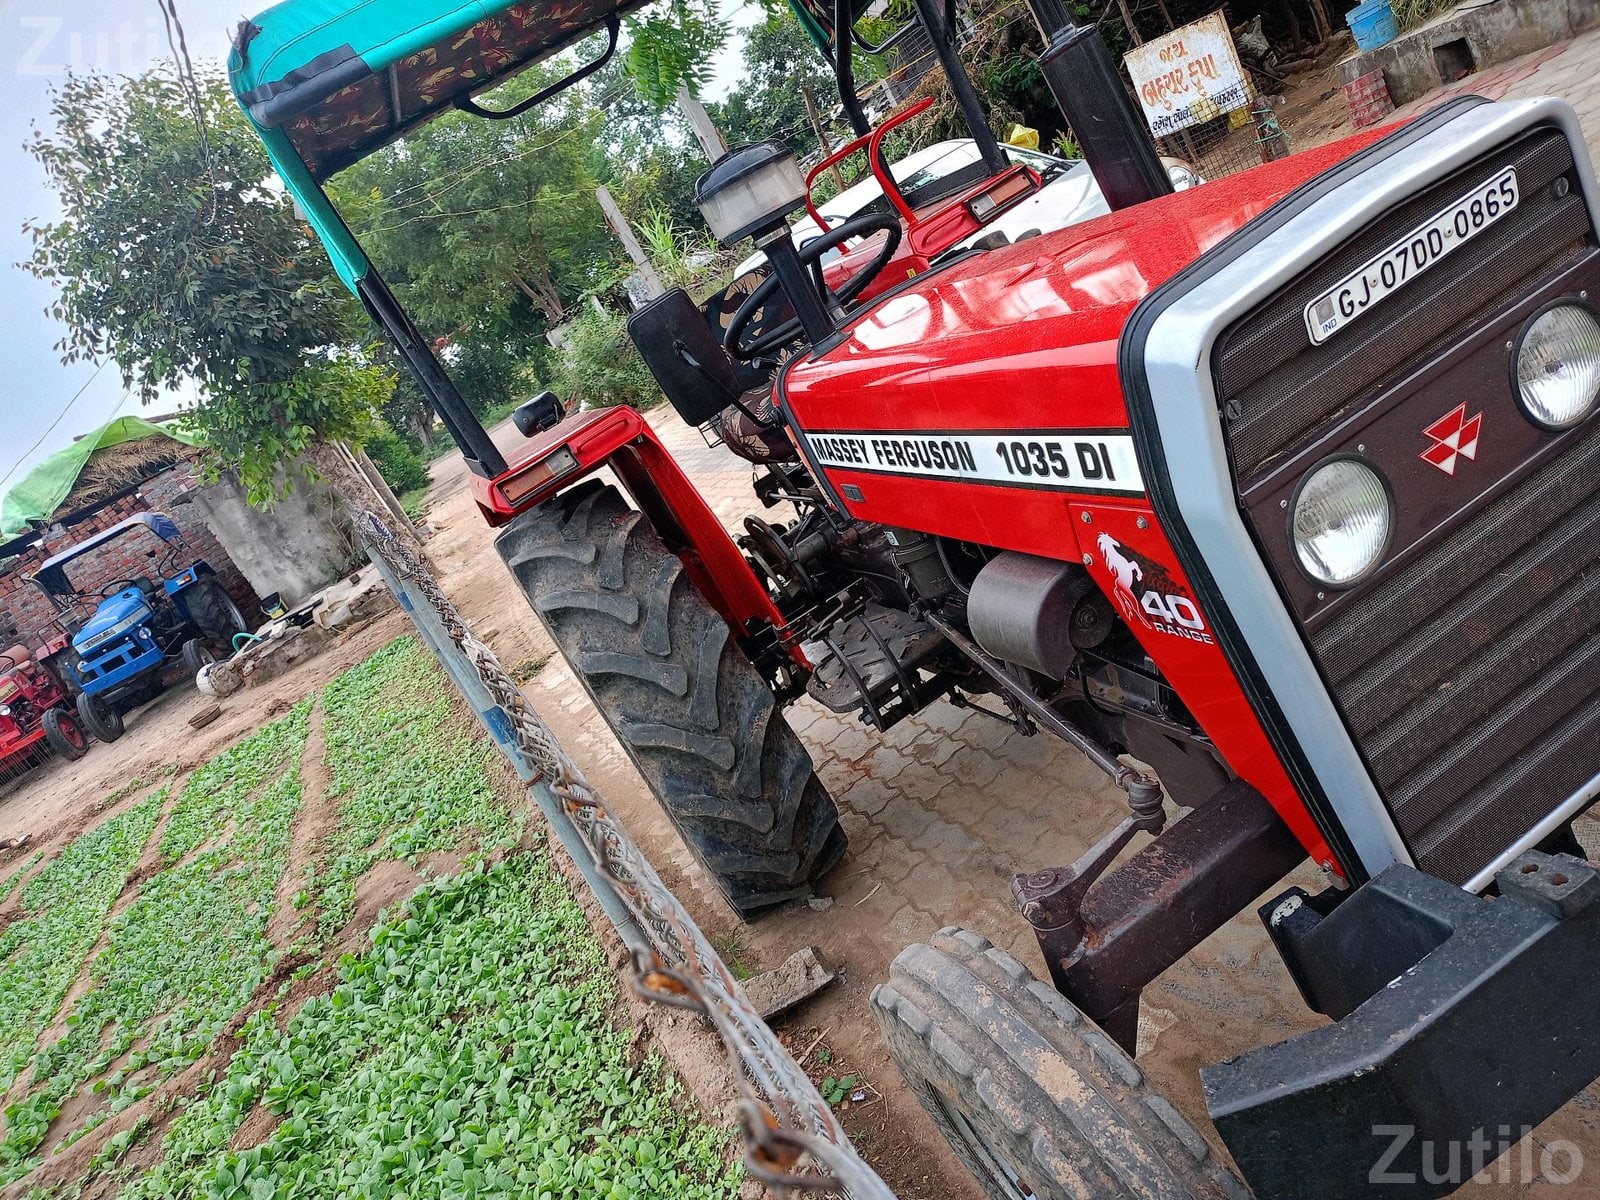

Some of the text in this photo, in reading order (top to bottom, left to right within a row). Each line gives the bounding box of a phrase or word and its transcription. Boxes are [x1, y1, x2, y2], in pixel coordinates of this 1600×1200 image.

[1338, 175, 1515, 317] GJ 07DD 0865
[1322, 318, 1337, 334] IND
[811, 438, 1117, 482] MASSEY FERGUSON 1035 DI
[1140, 590, 1205, 630] 40
[1153, 621, 1214, 645] RANGE
